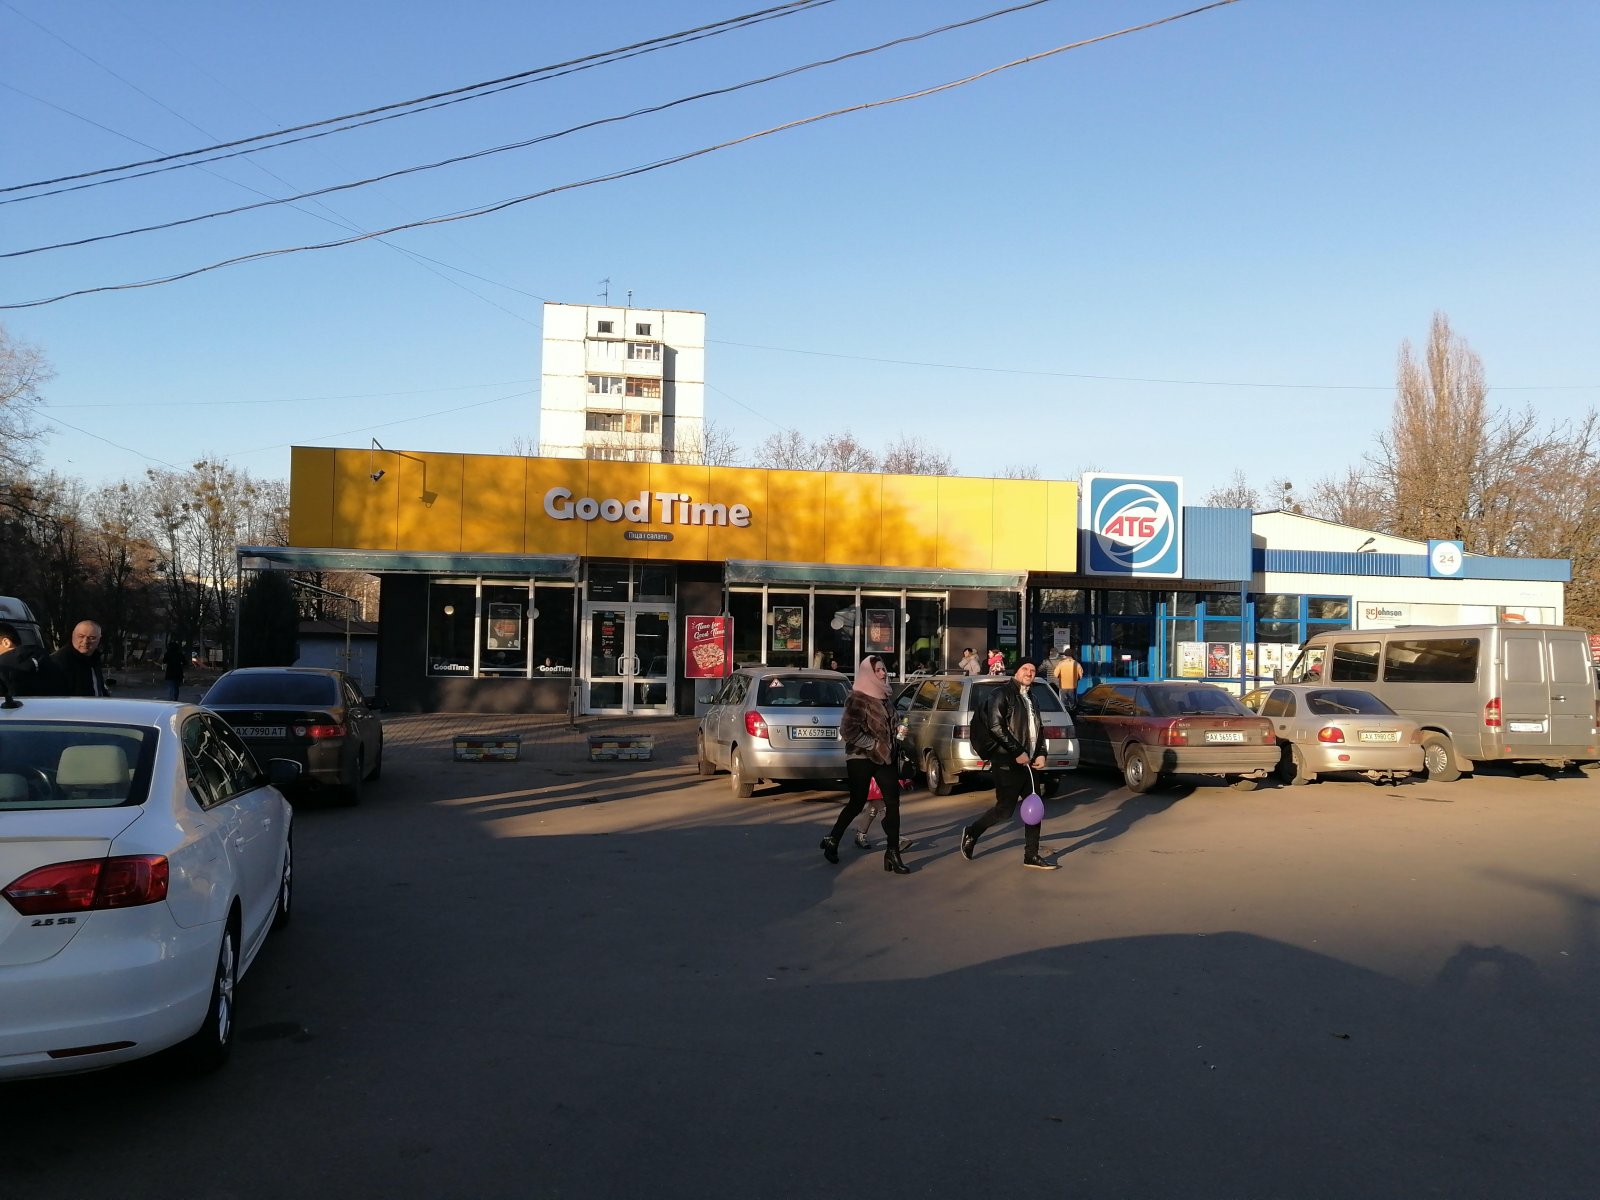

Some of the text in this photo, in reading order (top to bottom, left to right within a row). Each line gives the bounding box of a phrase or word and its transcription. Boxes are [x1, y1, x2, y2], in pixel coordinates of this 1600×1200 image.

[1439, 554, 1455, 564] 24
[250, 727, 270, 736] 7990
[271, 727, 284, 736] AT
[797, 729, 836, 737] AX 6579 EH
[57, 916, 77, 925] SE
